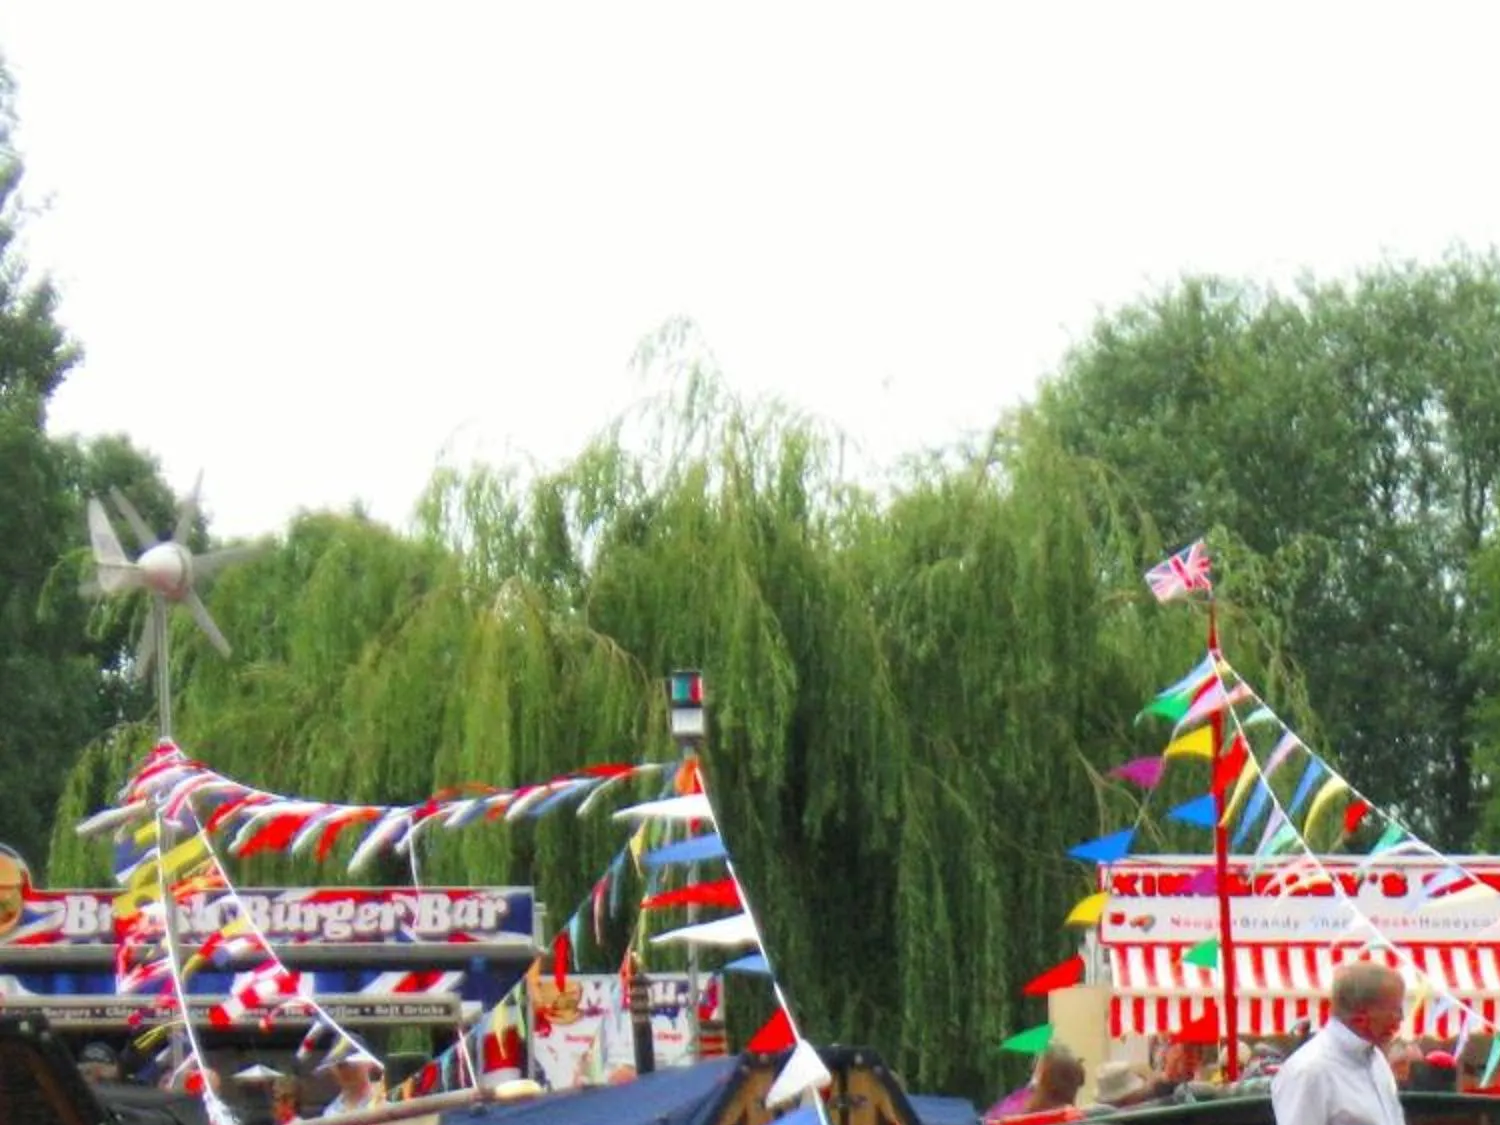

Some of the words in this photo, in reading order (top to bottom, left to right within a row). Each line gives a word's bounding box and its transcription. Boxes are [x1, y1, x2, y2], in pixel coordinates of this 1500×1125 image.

[245, 894, 407, 940] Burger
[412, 893, 507, 934] Bar
[1170, 915, 1229, 931] Noug
